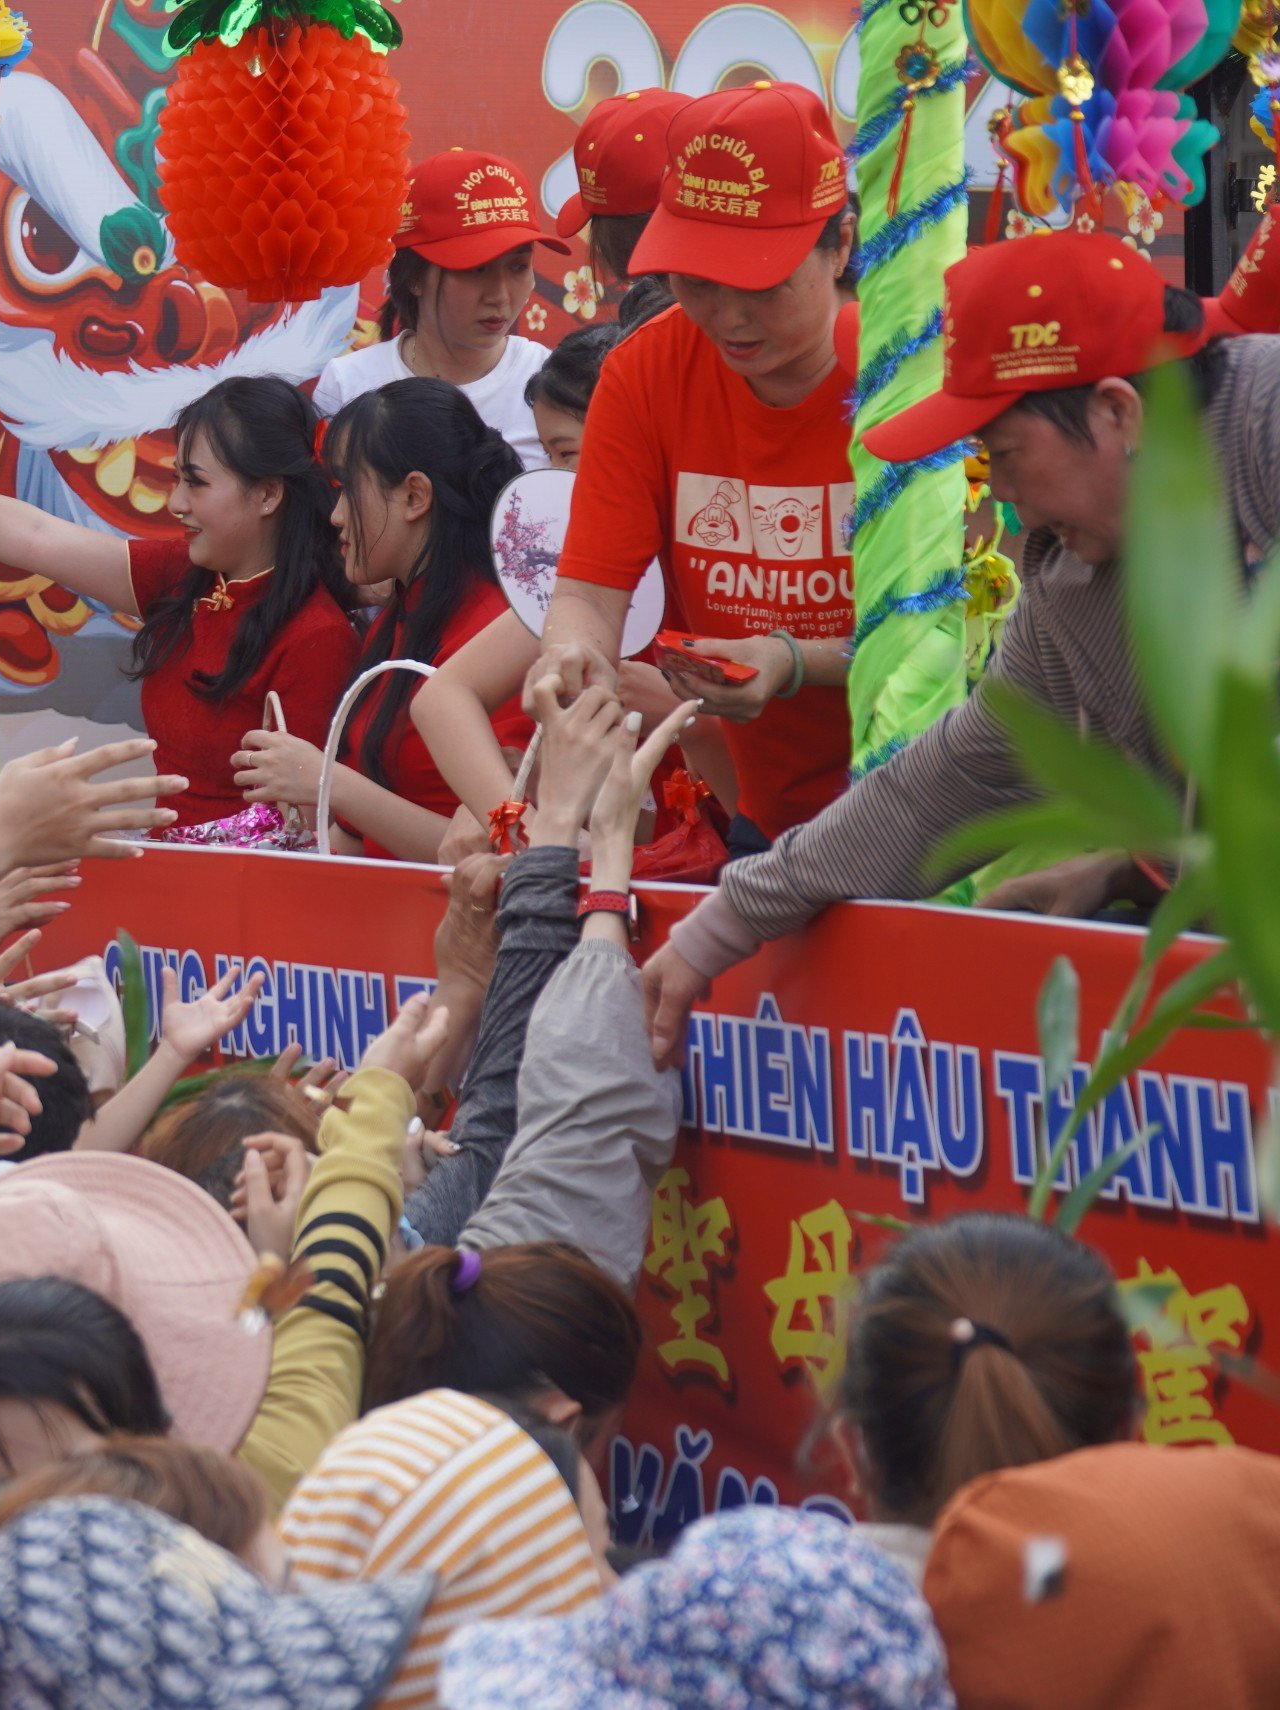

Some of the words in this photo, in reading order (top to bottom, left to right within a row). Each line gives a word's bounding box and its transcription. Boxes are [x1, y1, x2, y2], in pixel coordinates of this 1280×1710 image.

[1009, 320, 1061, 349] TDC
[786, 610, 813, 621] over
[821, 620, 843, 633] age
[214, 952, 390, 1074] NGHINH
[682, 991, 834, 1153] THIÊN
[843, 1006, 985, 1205] HẬU
